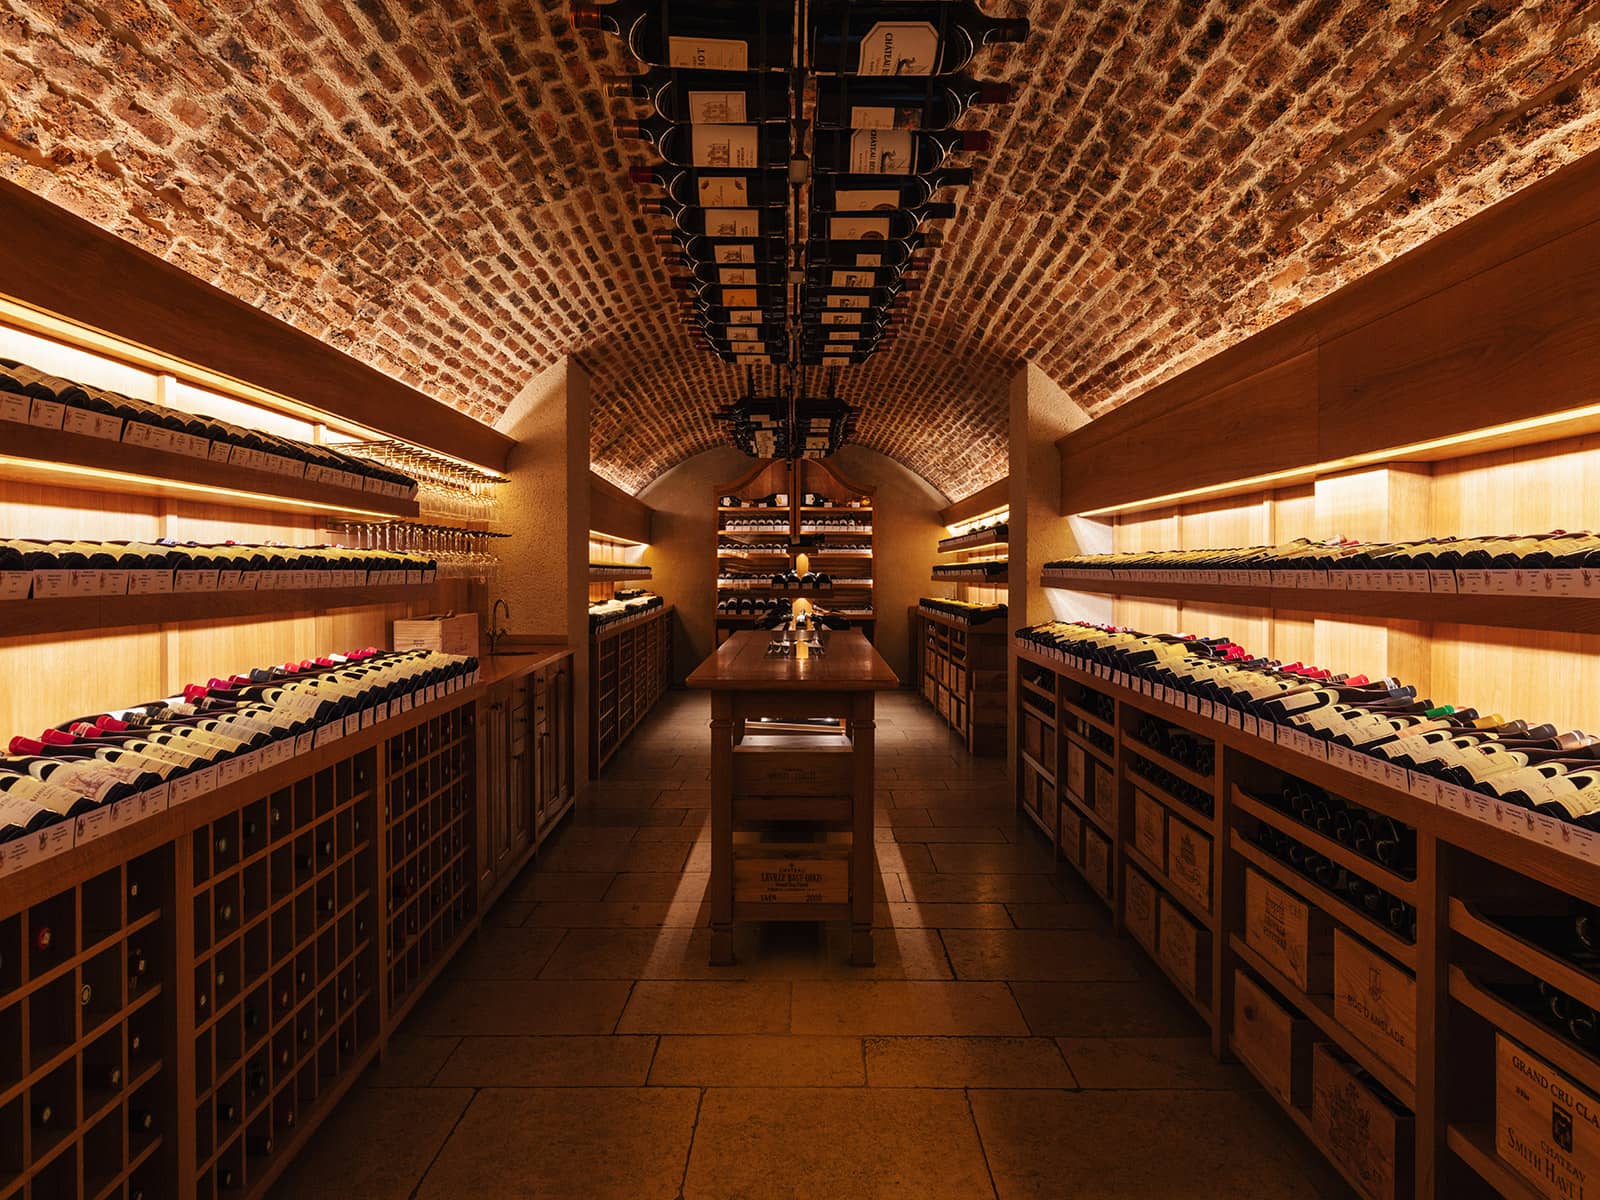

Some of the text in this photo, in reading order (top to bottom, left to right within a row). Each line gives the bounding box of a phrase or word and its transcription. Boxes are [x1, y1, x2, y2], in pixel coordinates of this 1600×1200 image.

[1512, 1055, 1548, 1088] GRAND
[1550, 1084, 1573, 1107] CRU
[1507, 1127, 1541, 1172] SMITH
